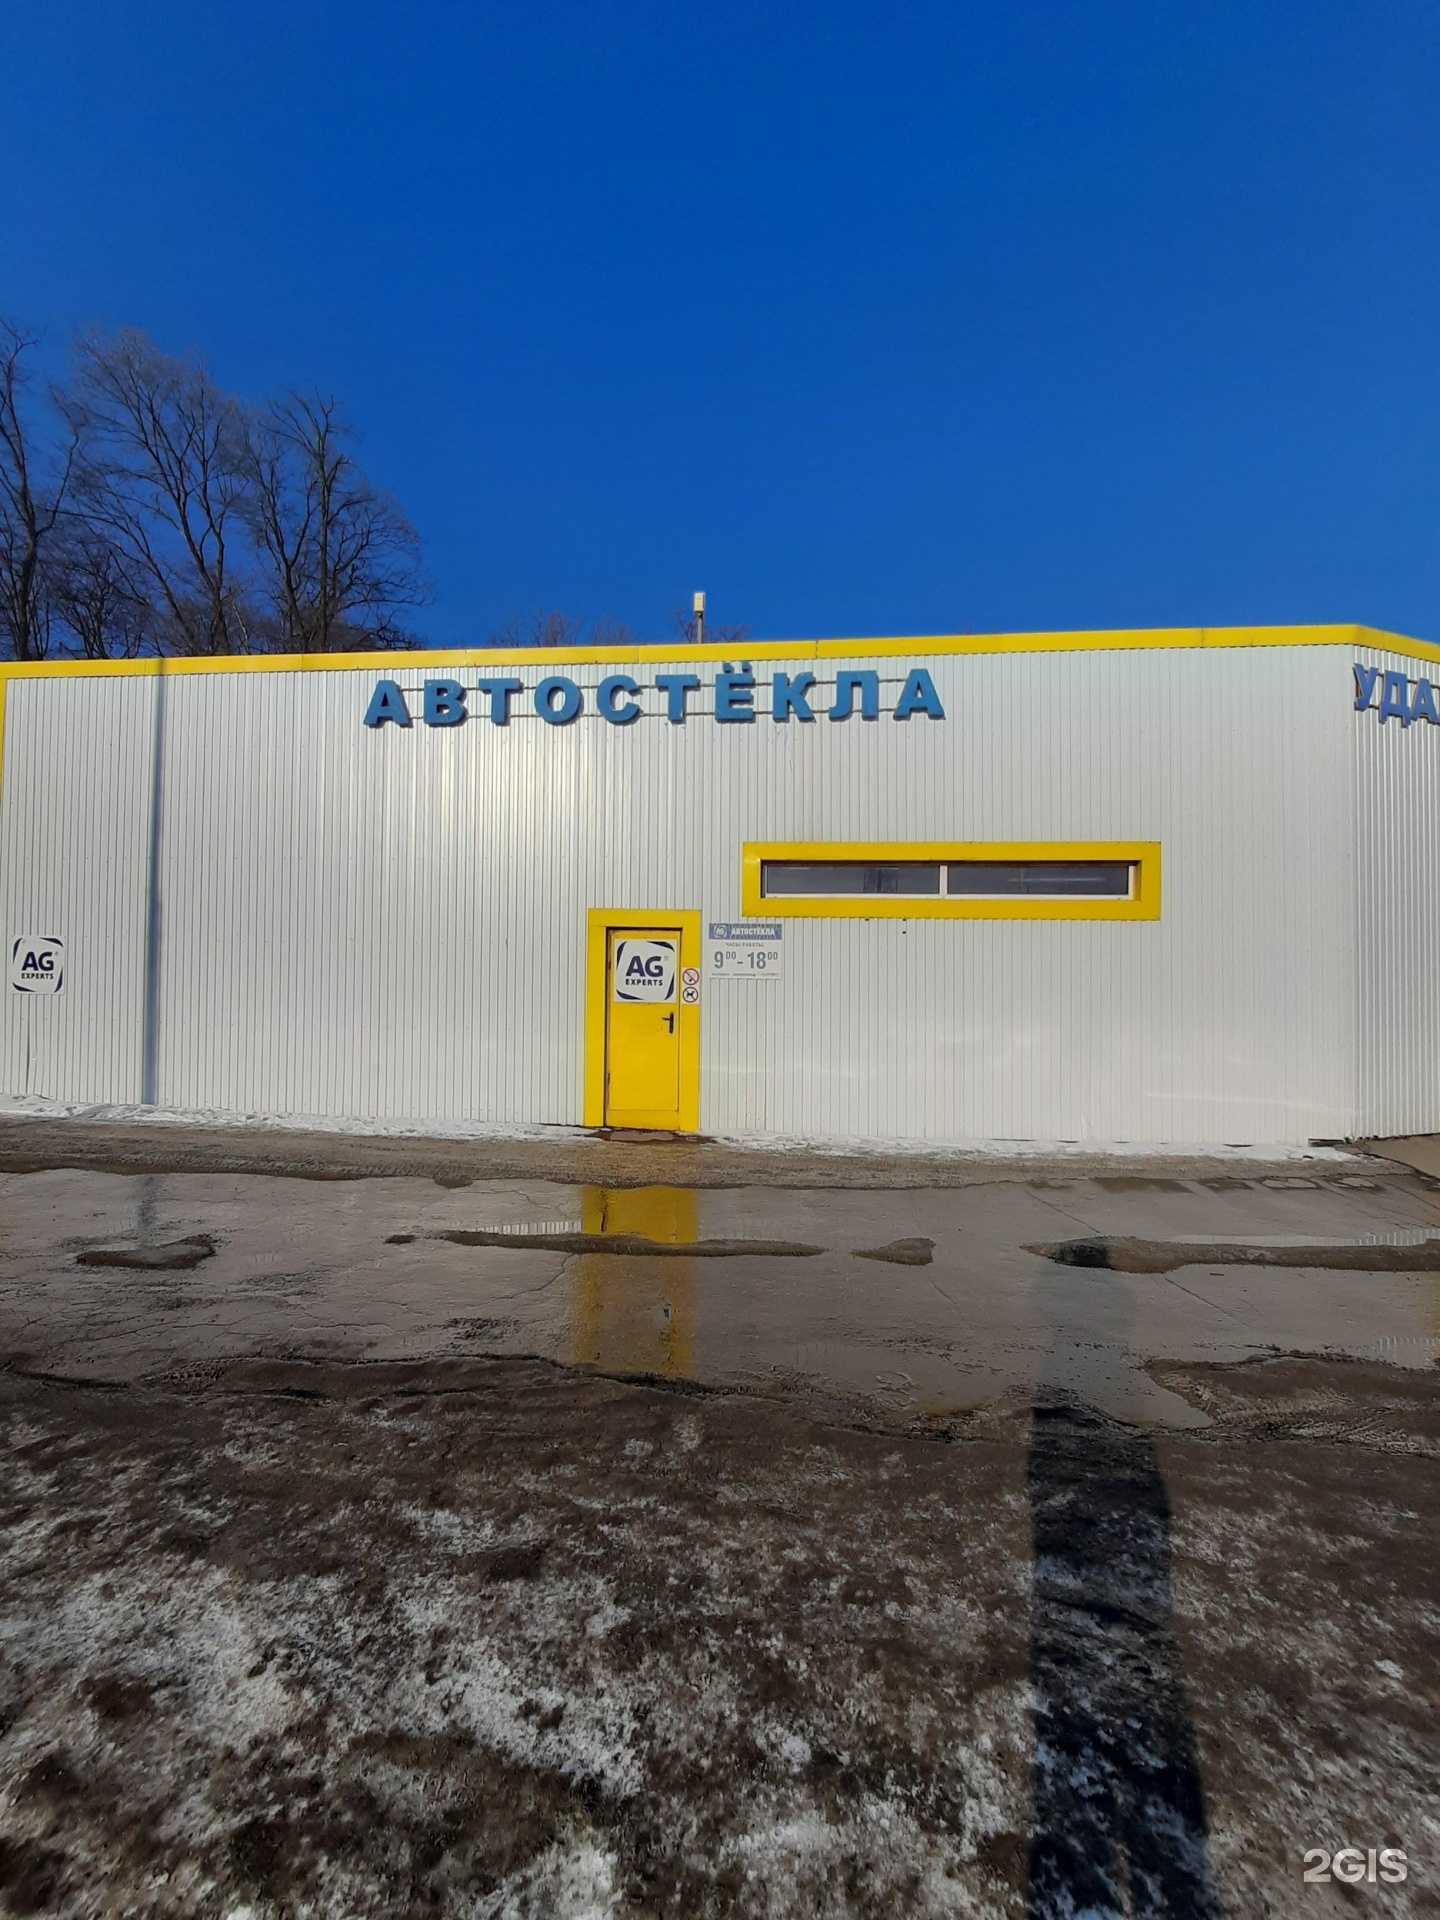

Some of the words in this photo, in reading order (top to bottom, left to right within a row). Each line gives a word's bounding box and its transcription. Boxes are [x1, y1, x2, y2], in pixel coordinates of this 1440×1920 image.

[363, 661, 945, 728] АВТОСТЁКЛА
[1353, 663, 1440, 728] УДА
[21, 951, 54, 971] AG
[626, 955, 663, 977] AG
[625, 978, 663, 986] EXPERTS
